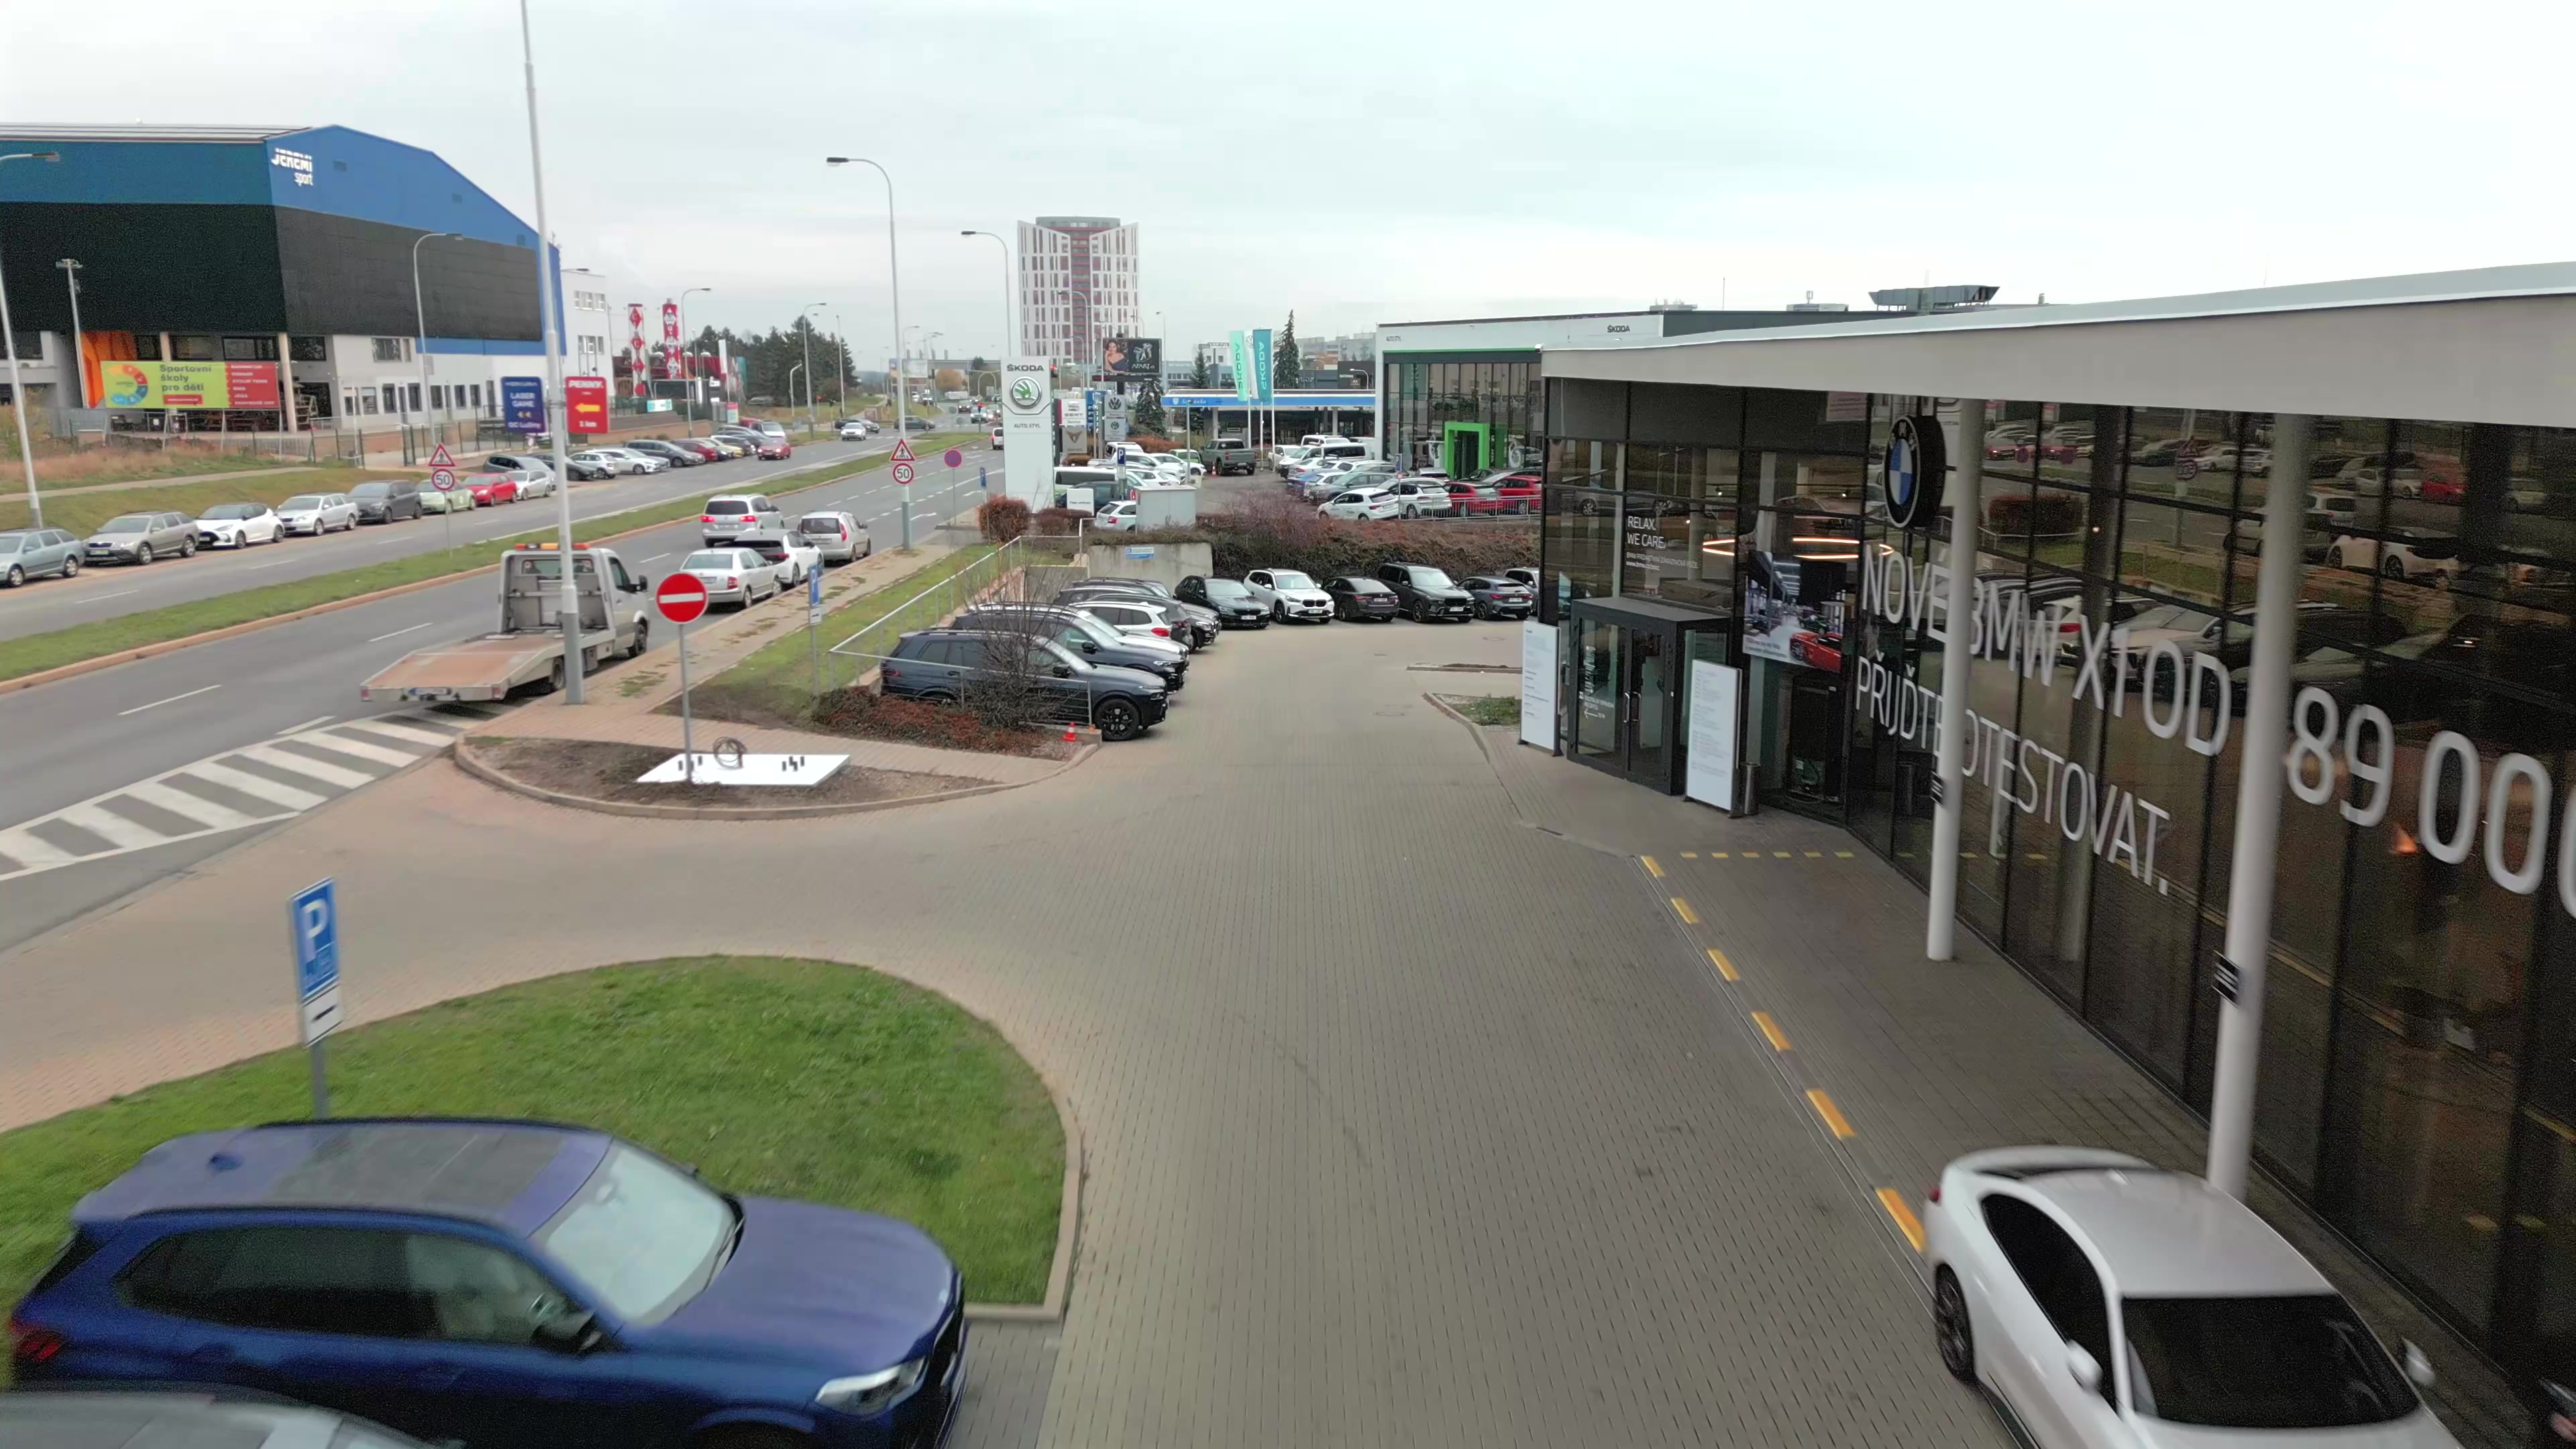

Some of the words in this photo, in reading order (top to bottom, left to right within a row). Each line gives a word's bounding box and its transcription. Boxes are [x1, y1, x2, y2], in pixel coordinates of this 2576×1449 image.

[294, 171, 313, 186] sport
[1607, 325, 1630, 333] ŠKODA
[1006, 364, 1044, 372] ŠKODA
[160, 374, 189, 382] školy
[162, 384, 180, 392] pro
[183, 383, 204, 391] děti
[1118, 449, 1124, 460] P
[897, 469, 910, 479] 50
[436, 474, 450, 486] 50
[1627, 532, 1640, 545] WE
[1862, 543, 1949, 644] NOVÉ
[2072, 614, 2130, 718] X1
[2143, 639, 2231, 757] OD
[2418, 729, 2576, 918] 00
[303, 900, 328, 963] P
